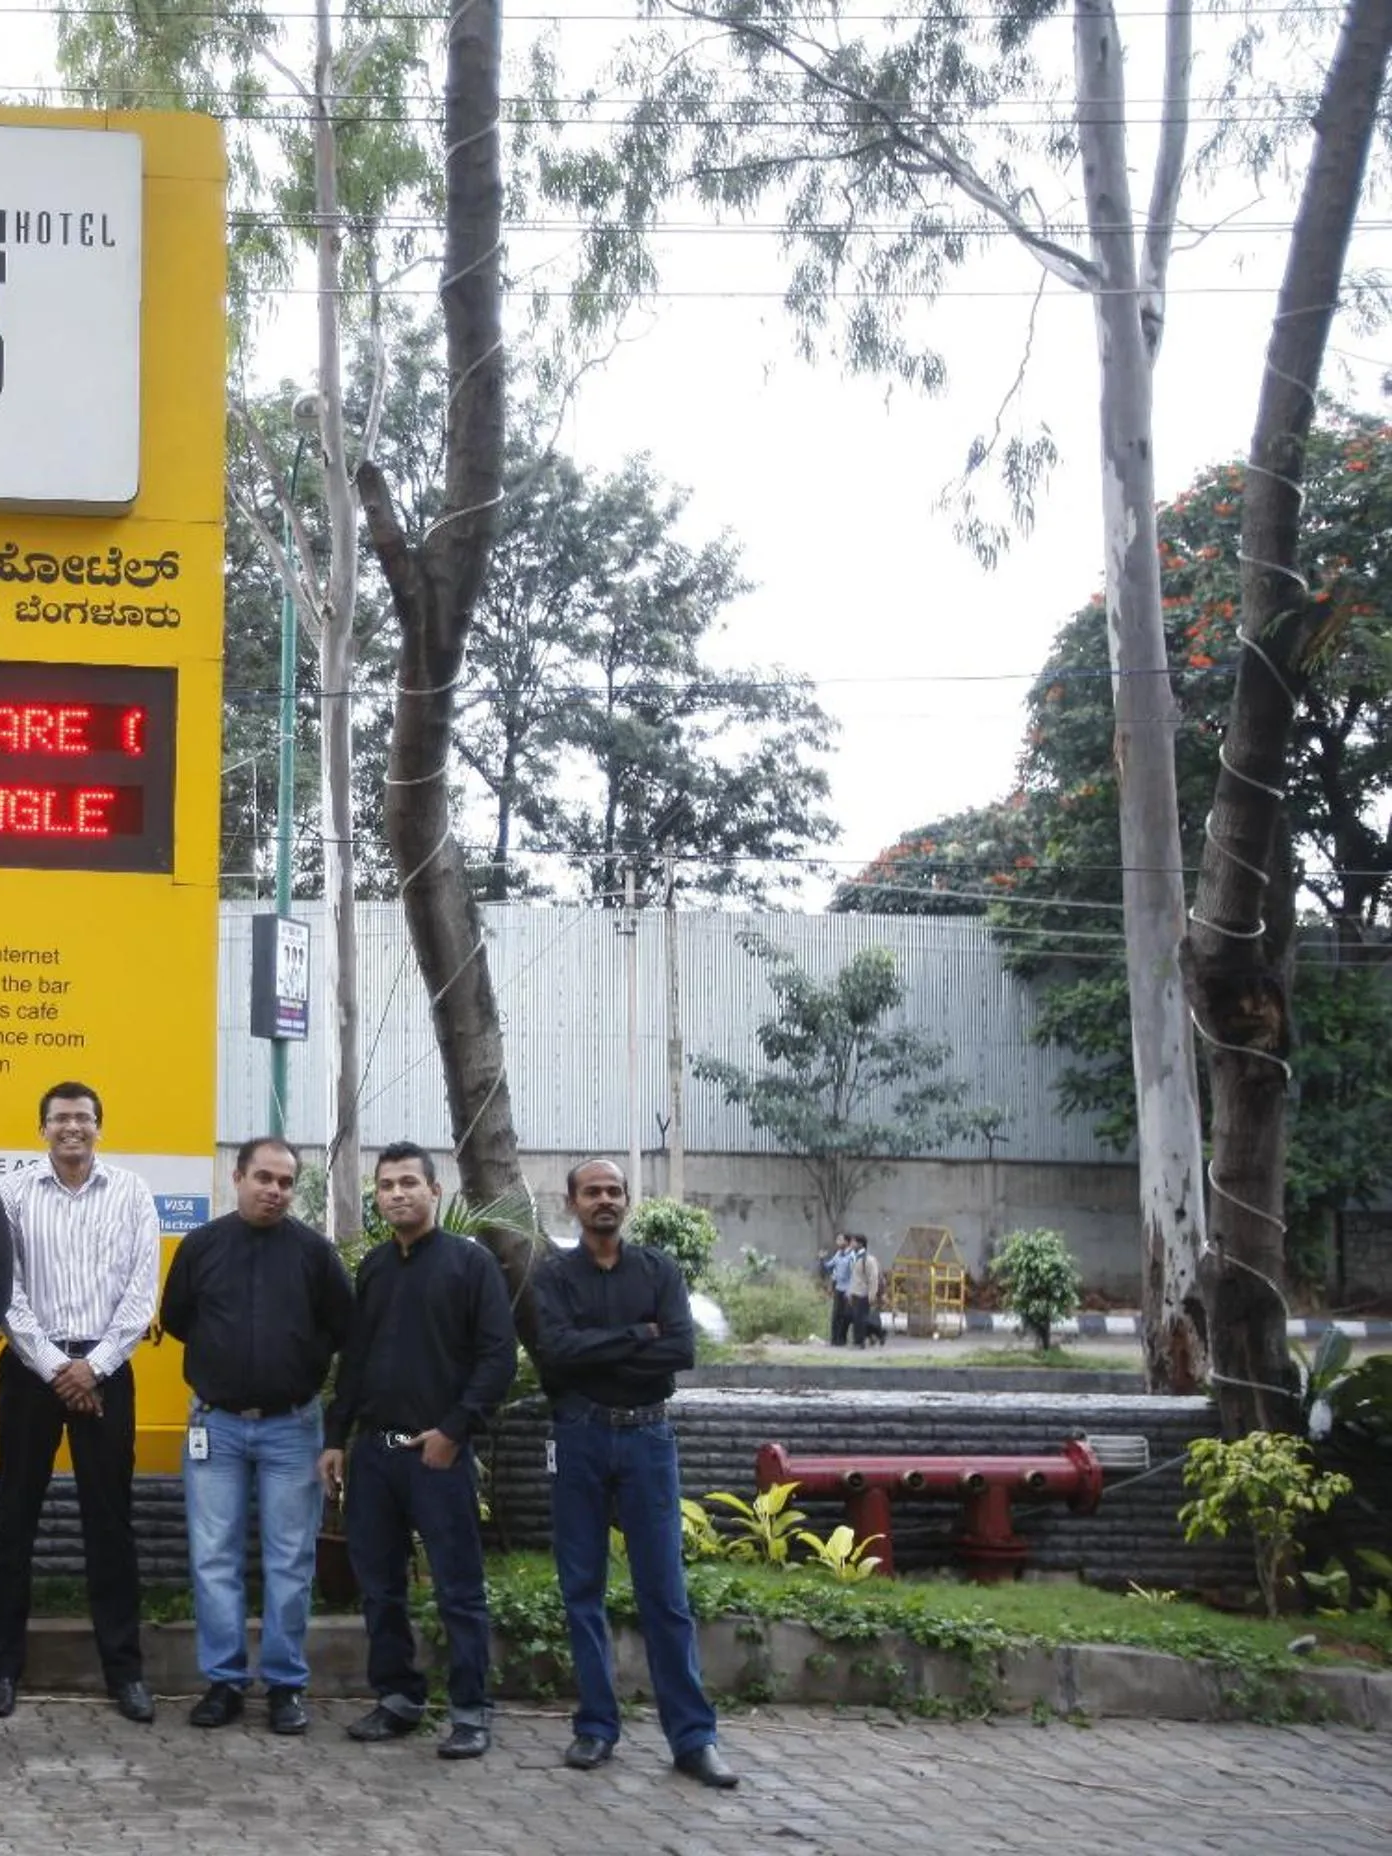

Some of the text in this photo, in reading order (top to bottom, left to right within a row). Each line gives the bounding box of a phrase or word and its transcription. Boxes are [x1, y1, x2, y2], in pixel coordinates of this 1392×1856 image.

[15, 209, 116, 247] HOTEL
[1, 975, 33, 993] the
[38, 975, 71, 995] bar
[34, 1033, 86, 1049] room
[163, 1198, 195, 1212] VISA
